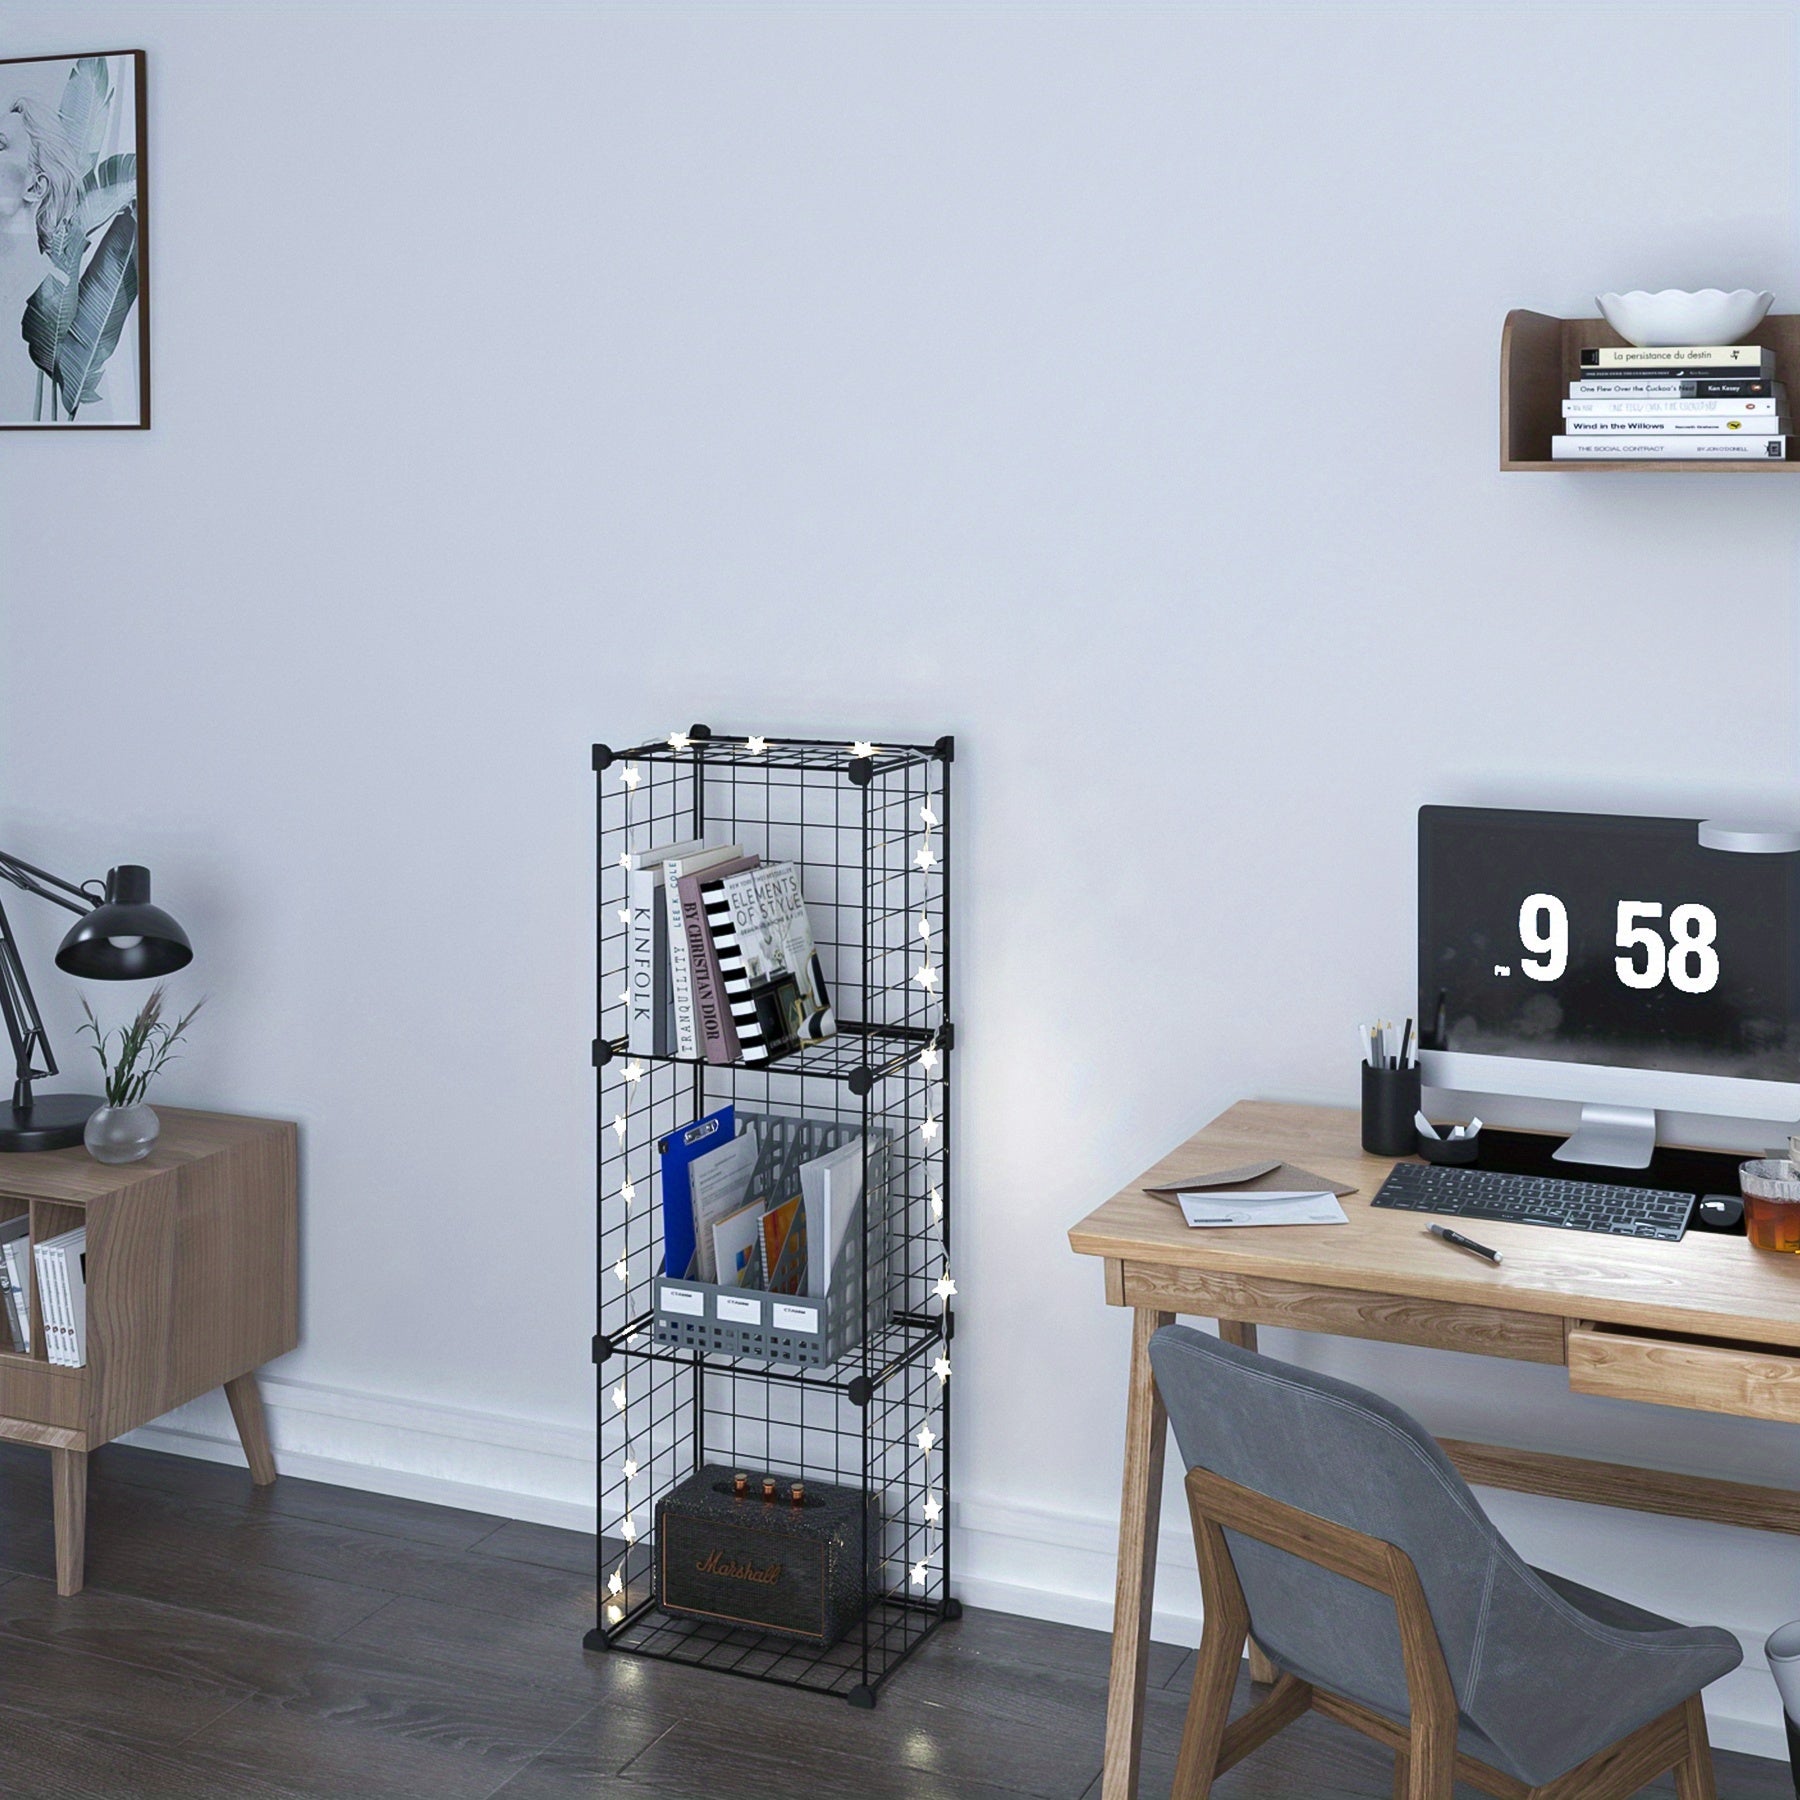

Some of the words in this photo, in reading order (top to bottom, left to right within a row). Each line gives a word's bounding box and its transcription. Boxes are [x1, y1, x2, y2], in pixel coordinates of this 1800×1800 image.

[1614, 352, 1624, 360] La
[1626, 351, 1672, 362] persistance
[1674, 350, 1685, 360] du
[1687, 350, 1712, 359] destin
[669, 862, 679, 888] COLE
[731, 876, 797, 910] ELEMENTS
[672, 910, 682, 928] LEE
[683, 901, 700, 921] BY
[736, 906, 755, 927] OF
[759, 892, 802, 919] STYLE
[1518, 893, 1569, 982] 9
[1614, 900, 1720, 994] 58
[634, 907, 651, 1021] KINFOLK
[687, 924, 714, 1000] CHRISTIAN
[673, 946, 693, 1052] TRANQUILITY
[701, 1004, 720, 1041] DIOR
[696, 1549, 782, 1586] Marshall
